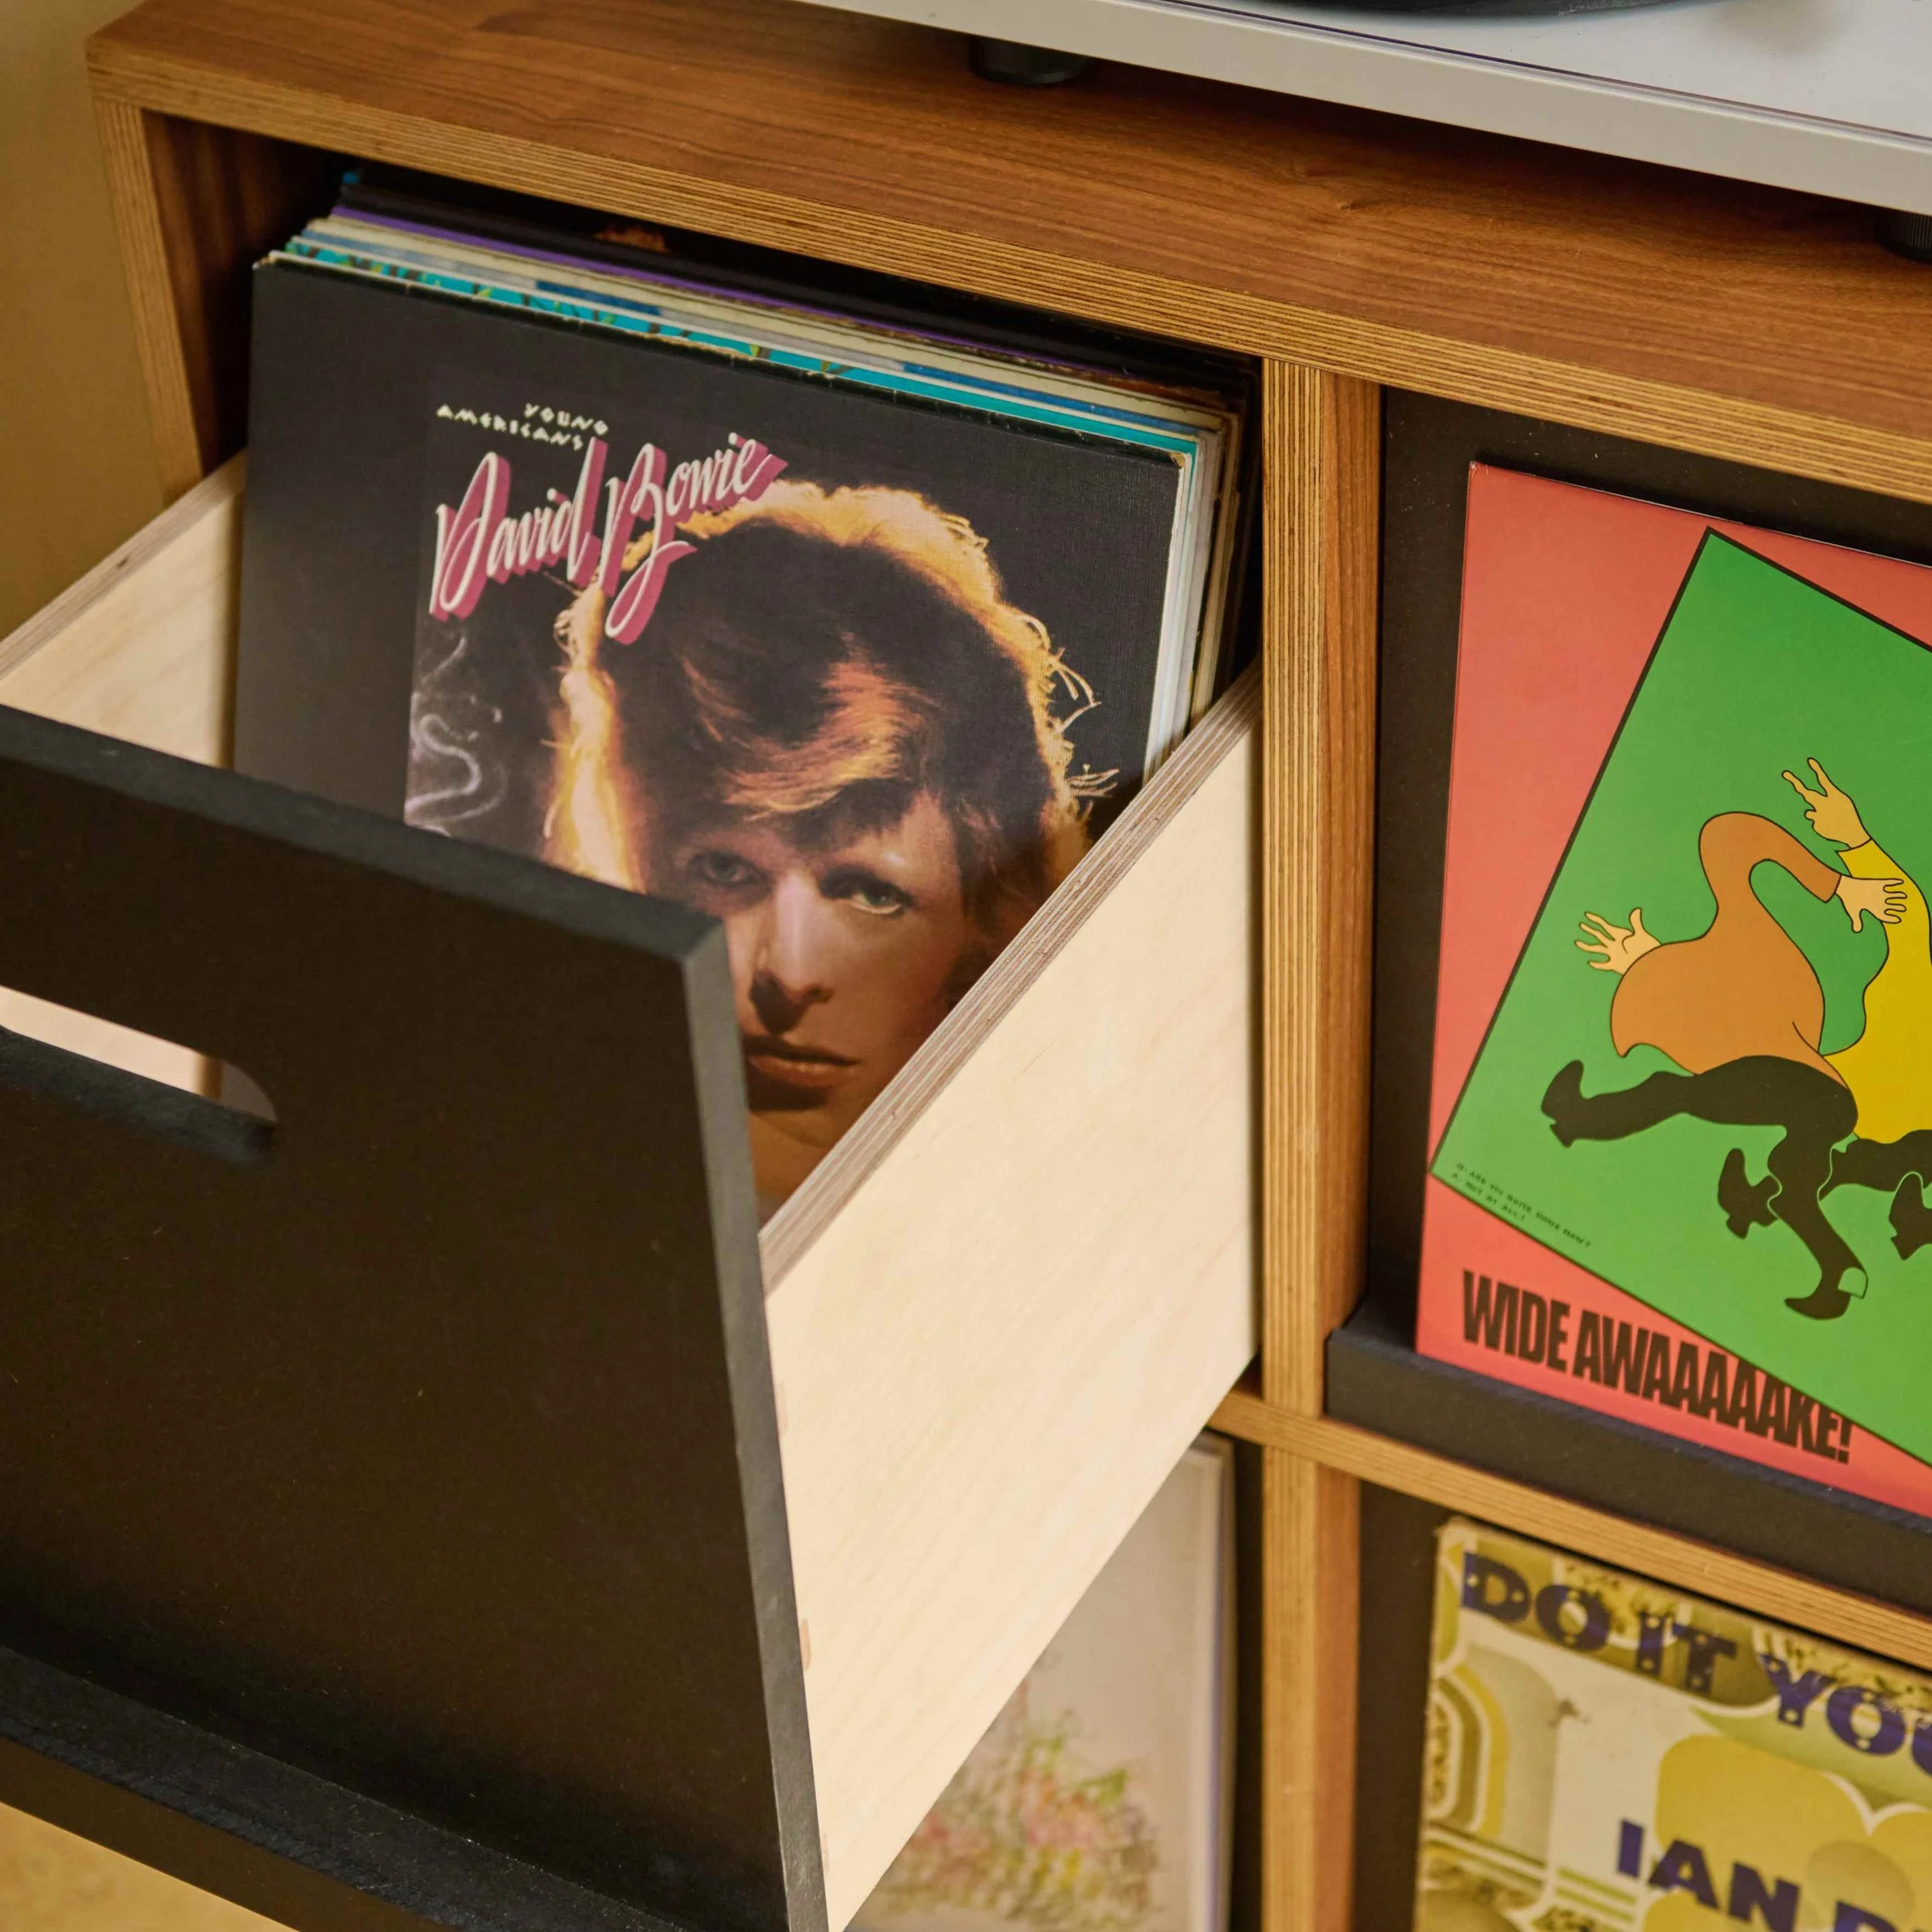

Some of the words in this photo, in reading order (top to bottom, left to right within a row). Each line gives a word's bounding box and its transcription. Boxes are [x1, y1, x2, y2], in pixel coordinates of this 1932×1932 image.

[436, 403, 583, 451] AMERICANS
[523, 403, 609, 436] YOUNG
[430, 437, 608, 621] David
[597, 432, 788, 644] Bowie
[1463, 1269, 1570, 1373] WIDE
[1461, 1552, 1611, 1651] DO
[1635, 1610, 1737, 1695] IT
[1617, 1819, 1801, 1932] IAN
